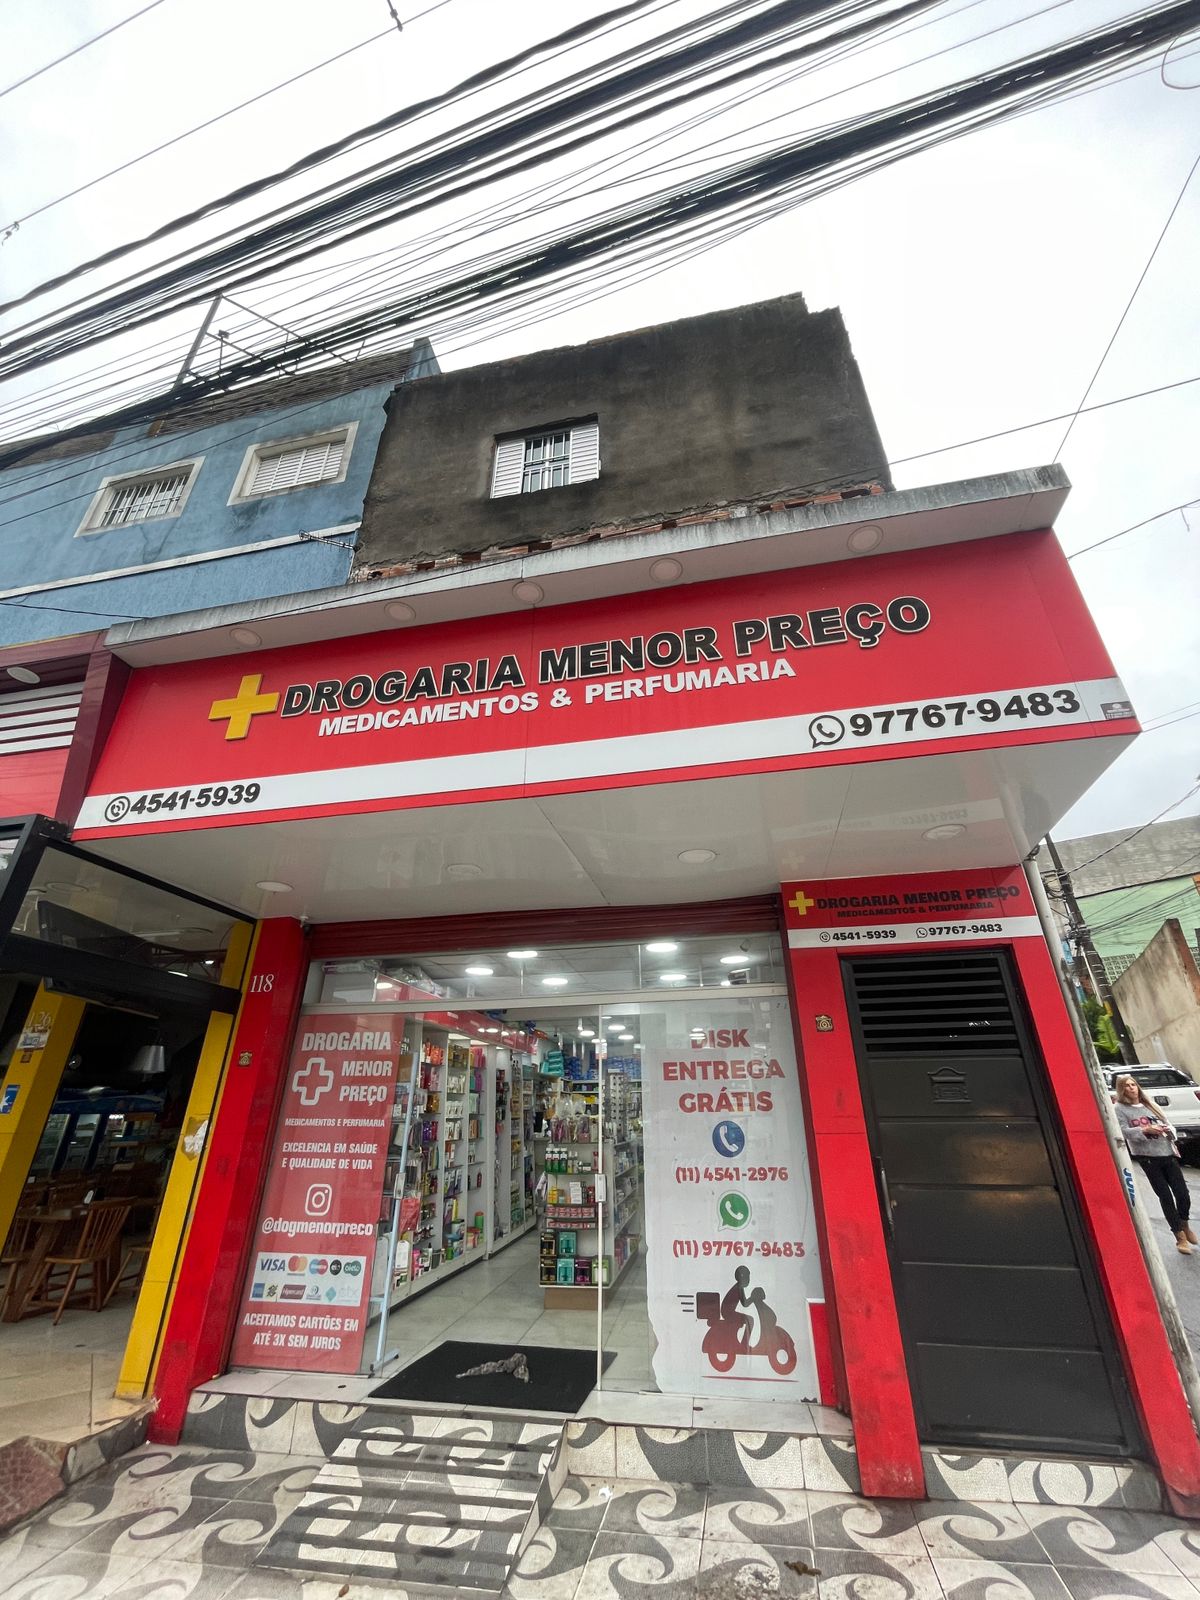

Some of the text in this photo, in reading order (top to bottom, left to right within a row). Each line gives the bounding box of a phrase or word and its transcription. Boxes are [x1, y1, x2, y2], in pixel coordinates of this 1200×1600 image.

[280, 596, 932, 718] DROGARIA MENOR PREÇO
[318, 658, 797, 737] MEDICAMENTOS & PERFUMARIA
[850, 689, 1081, 737] 97767-9483
[130, 783, 261, 815] 4541-5939
[817, 885, 1021, 909] DROGARIA MENOR PREÇO
[837, 906, 915, 918] MEDICAMENTOS
[928, 902, 995, 913] PERFUMARIA
[832, 924, 1003, 941] 4541-5939 97767-9483
[250, 974, 275, 993] 118
[301, 1031, 392, 1051] DROGARIA
[690, 1029, 750, 1050] DISK
[341, 1060, 393, 1077] MENOR
[662, 1059, 786, 1082] ENTREGA
[339, 1085, 388, 1106] PREÇO
[678, 1086, 774, 1114] GRÁTIS
[285, 1118, 385, 1128] MEDICAMENTOS E PERFUMARIA
[282, 1141, 378, 1154] EXCELENCIA EM SAÚDE
[281, 1158, 373, 1170] E QUALIDADE DE VIDA
[675, 1166, 789, 1184] (11) 4541-2976
[261, 1217, 374, 1238] @dogmenorpreco
[672, 1239, 806, 1258] (11) 97767-9483
[260, 1258, 286, 1272] VISA
[243, 1312, 359, 1332] ACEITAMOS CARTÕES EM
[253, 1330, 342, 1350] ATÉ 3X SEM JUROS
